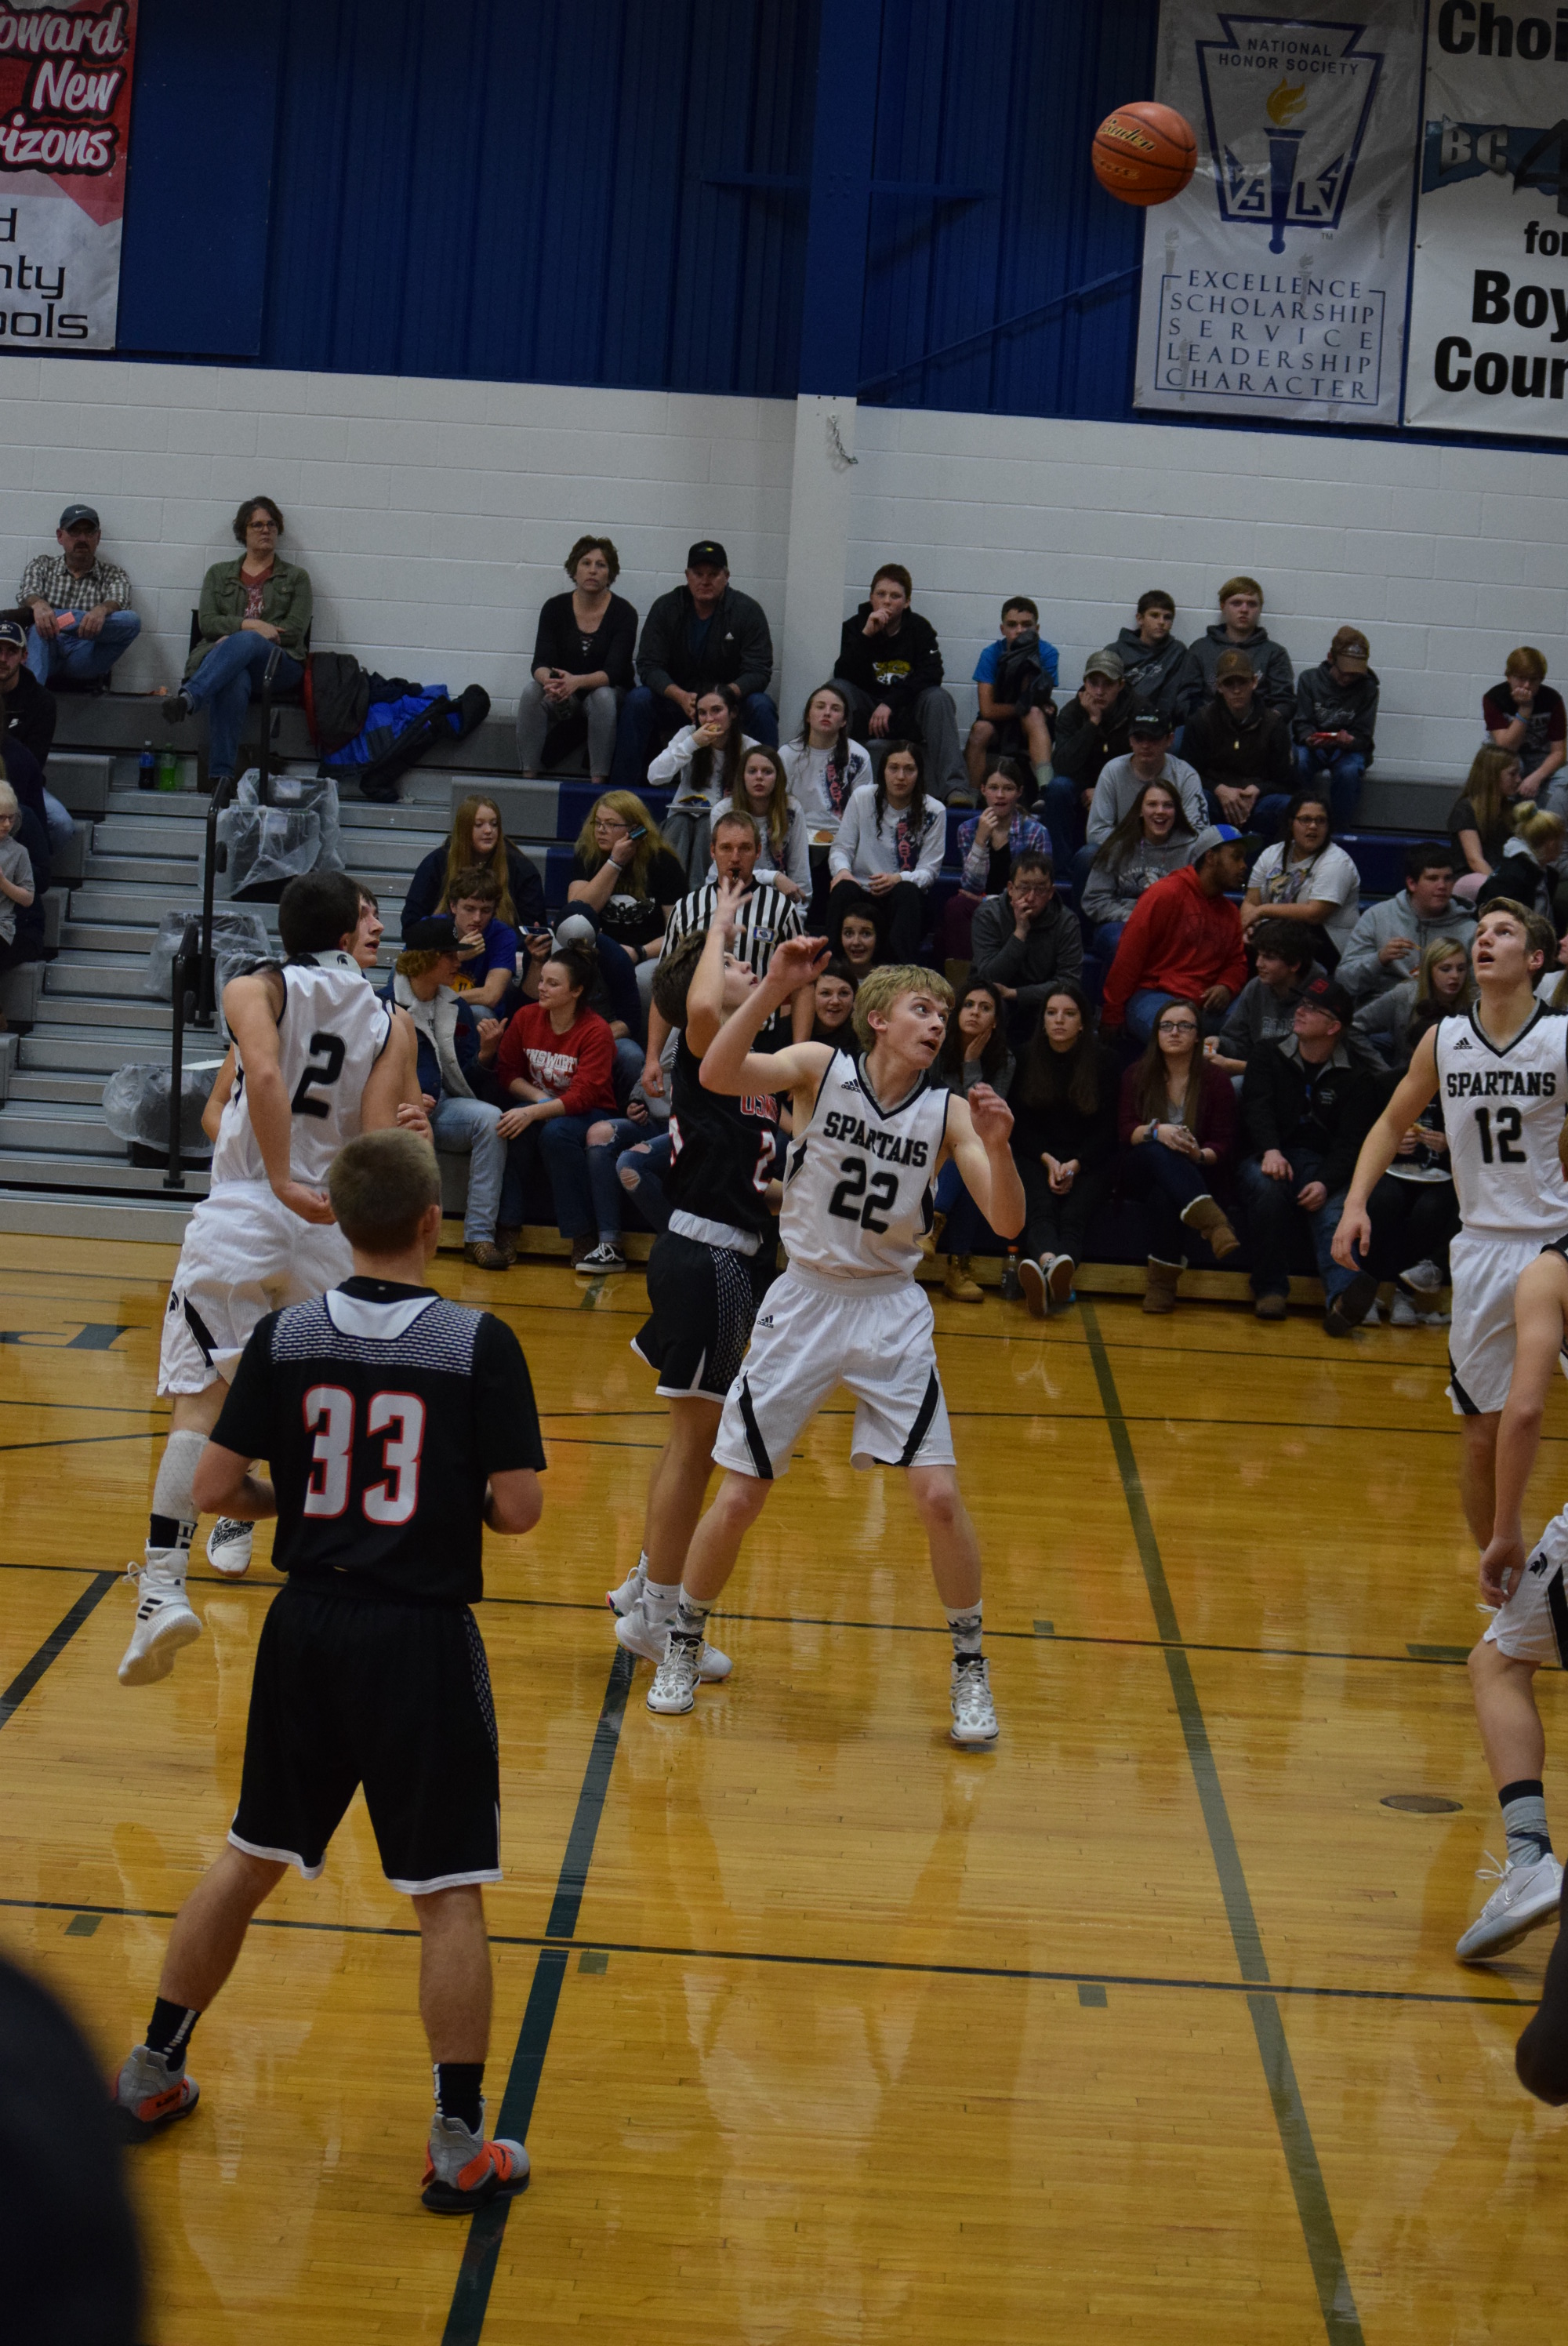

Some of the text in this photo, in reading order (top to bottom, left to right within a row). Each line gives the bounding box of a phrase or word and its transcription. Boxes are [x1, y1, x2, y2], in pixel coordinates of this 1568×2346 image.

[0, 5, 123, 55] oward
[1248, 38, 1332, 57] NATIONAL
[1219, 53, 1359, 76] HONOR SOCIETY
[31, 60, 120, 112] New
[1439, 118, 1509, 178] BC
[1189, 269, 1361, 299] EXCELLENCE
[1171, 292, 1374, 325] SCHOLARSHIP
[1169, 318, 1373, 350] SERVICE
[1167, 343, 1370, 374] LEADERSHIP
[1167, 368, 1368, 400] CHARACTER
[291, 1032, 345, 1119] 2
[1446, 1071, 1556, 1098] SPARTANS
[823, 1111, 929, 1168] SPARTANS
[1475, 1106, 1526, 1164] 12
[828, 1157, 898, 1234] 22
[301, 1383, 427, 1527] 33
